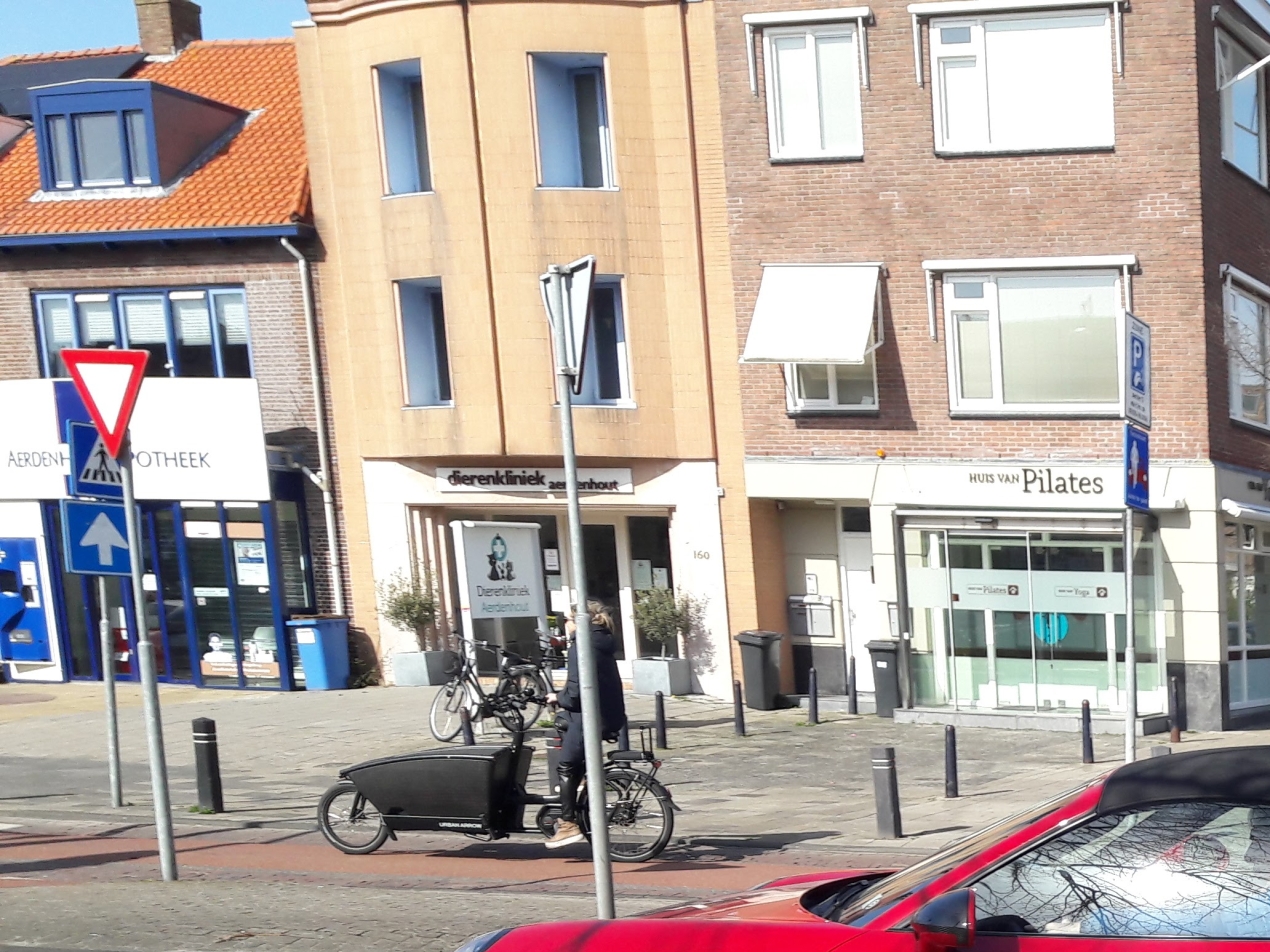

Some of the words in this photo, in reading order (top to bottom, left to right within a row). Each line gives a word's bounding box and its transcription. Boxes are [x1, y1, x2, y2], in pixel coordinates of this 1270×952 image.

[131, 450, 211, 468] OTHEEK
[447, 470, 546, 487] dierenkliniek
[548, 478, 619, 491] aerenhout
[969, 472, 995, 484] HUIS
[997, 473, 1020, 484] VAN
[1021, 468, 1104, 494] Pilates
[693, 550, 710, 560] 160
[476, 585, 530, 597] Dierenkliniek
[983, 585, 1007, 594] Pilates
